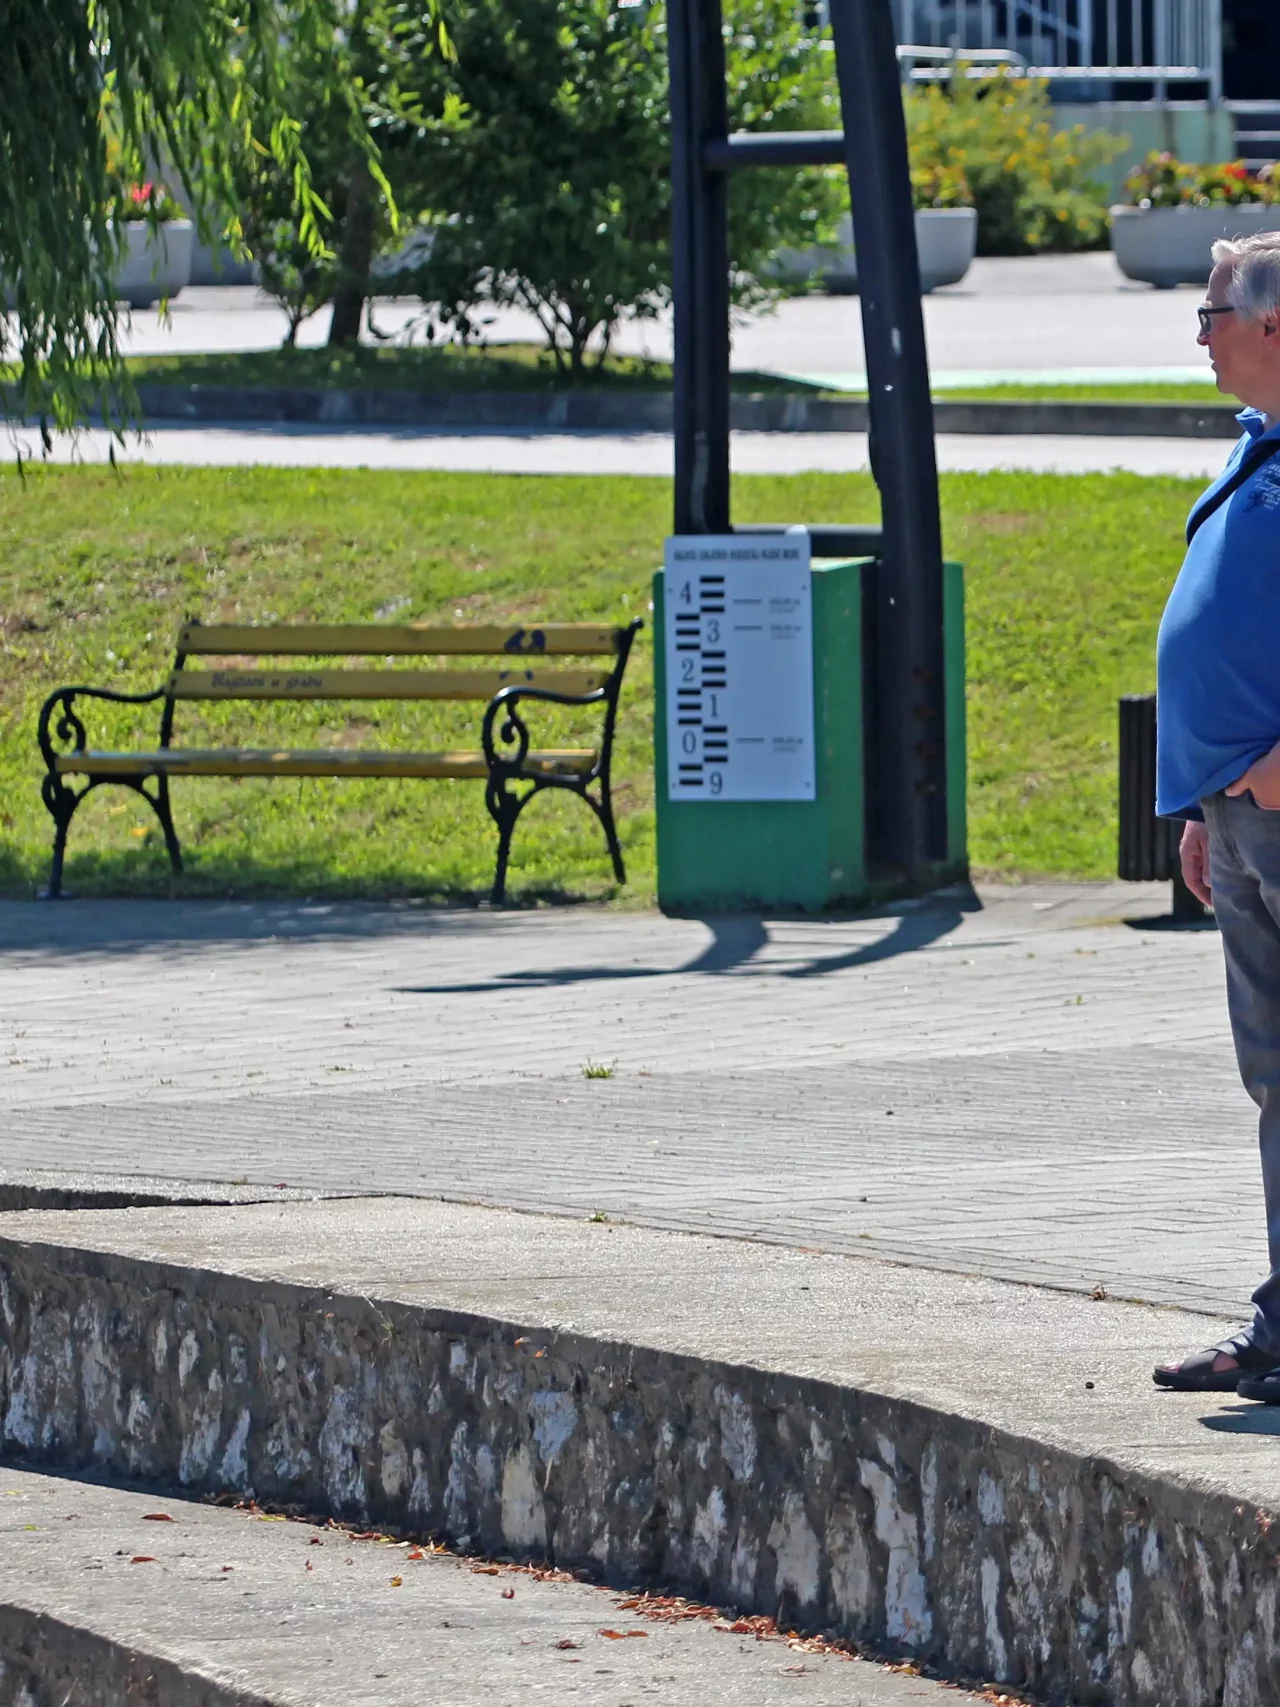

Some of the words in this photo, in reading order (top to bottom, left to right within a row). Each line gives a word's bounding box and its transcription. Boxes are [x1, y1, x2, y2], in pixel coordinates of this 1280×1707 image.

[680, 581, 692, 604] 4
[707, 619, 720, 643] 3
[681, 658, 694, 682] 2
[710, 694, 718, 718] 1
[682, 730, 696, 754] 0
[710, 771, 723, 795] 9
